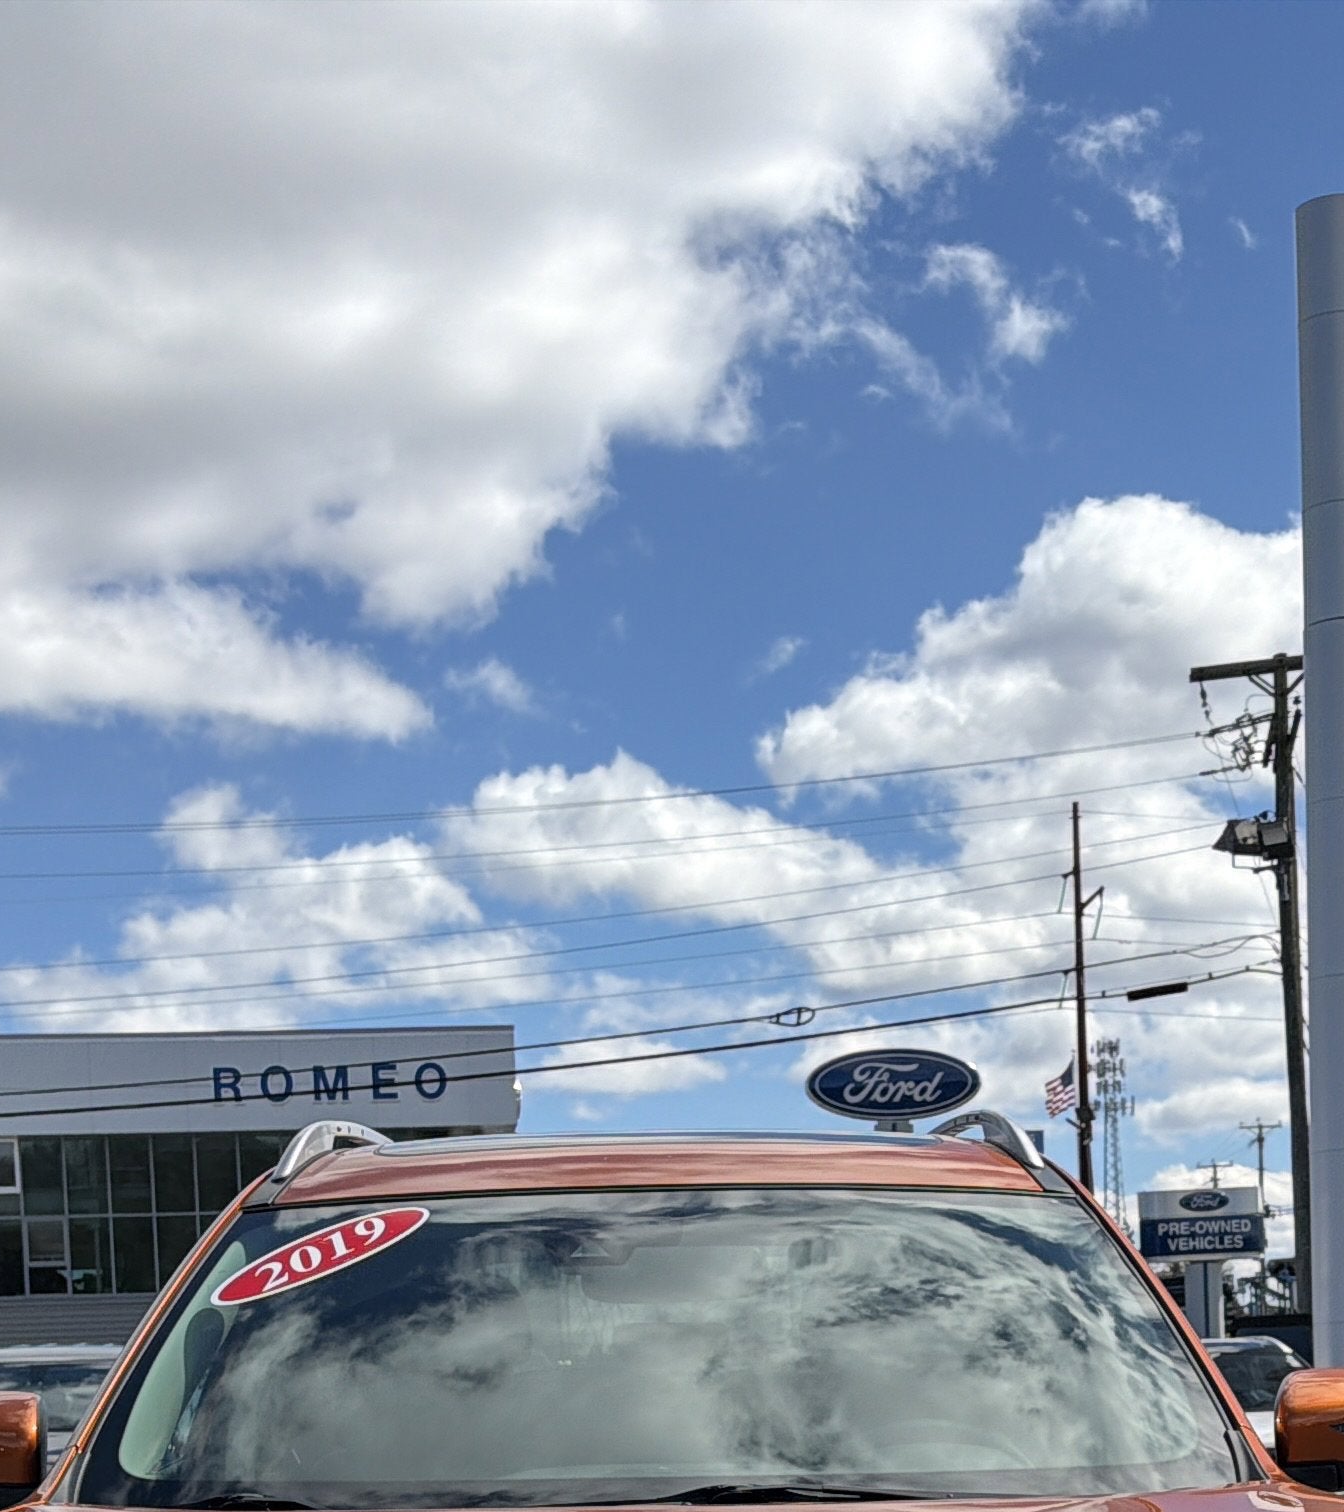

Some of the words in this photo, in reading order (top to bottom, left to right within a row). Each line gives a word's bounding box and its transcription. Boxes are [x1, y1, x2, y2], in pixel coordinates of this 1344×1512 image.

[212, 1062, 448, 1102] ROMEO
[842, 1062, 945, 1104] Ford
[1189, 1194, 1222, 1209] Ford
[1157, 1219, 1252, 1236] PRE-OWNED
[255, 1216, 387, 1292] 2019
[1167, 1235, 1244, 1251] VEHICLES
